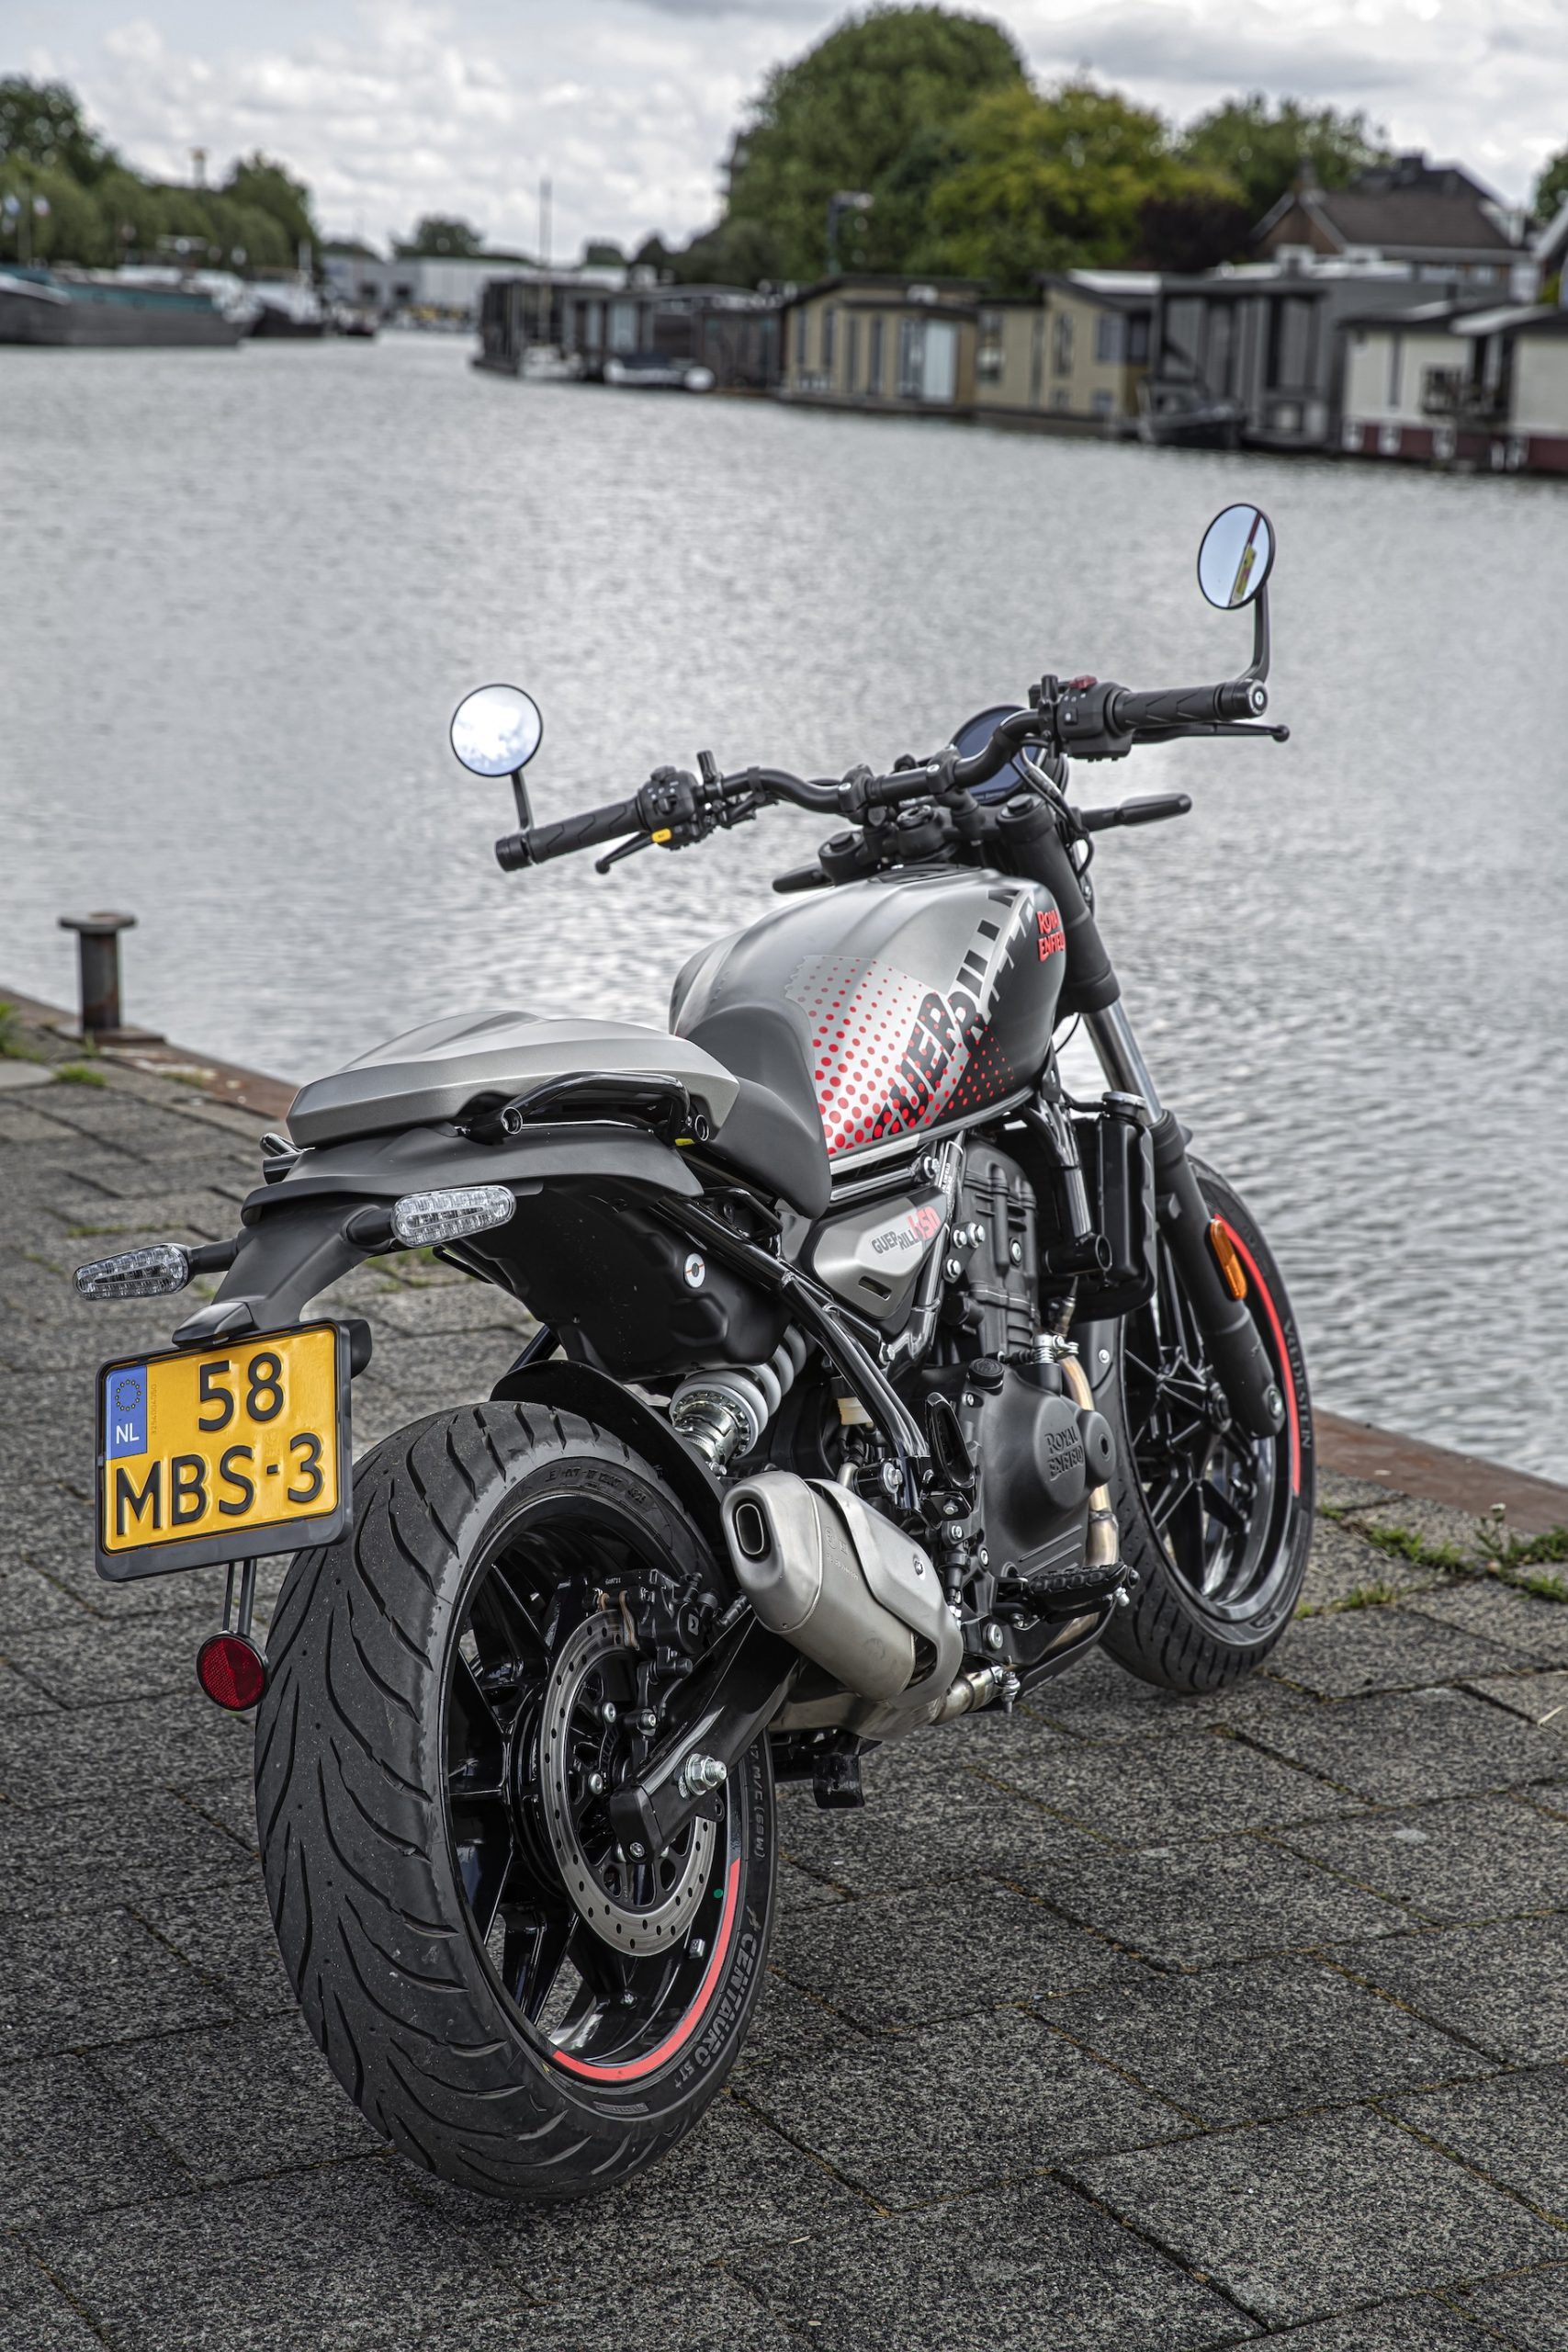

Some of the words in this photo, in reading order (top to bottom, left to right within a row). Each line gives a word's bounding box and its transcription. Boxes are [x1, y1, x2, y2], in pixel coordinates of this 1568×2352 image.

[198, 1351, 284, 1432] 58
[116, 1423, 140, 1444] NL
[1044, 1426, 1078, 1453] ROYAL
[116, 1433, 322, 1536] MBS-3
[694, 1932, 757, 2067] CENTAURO
